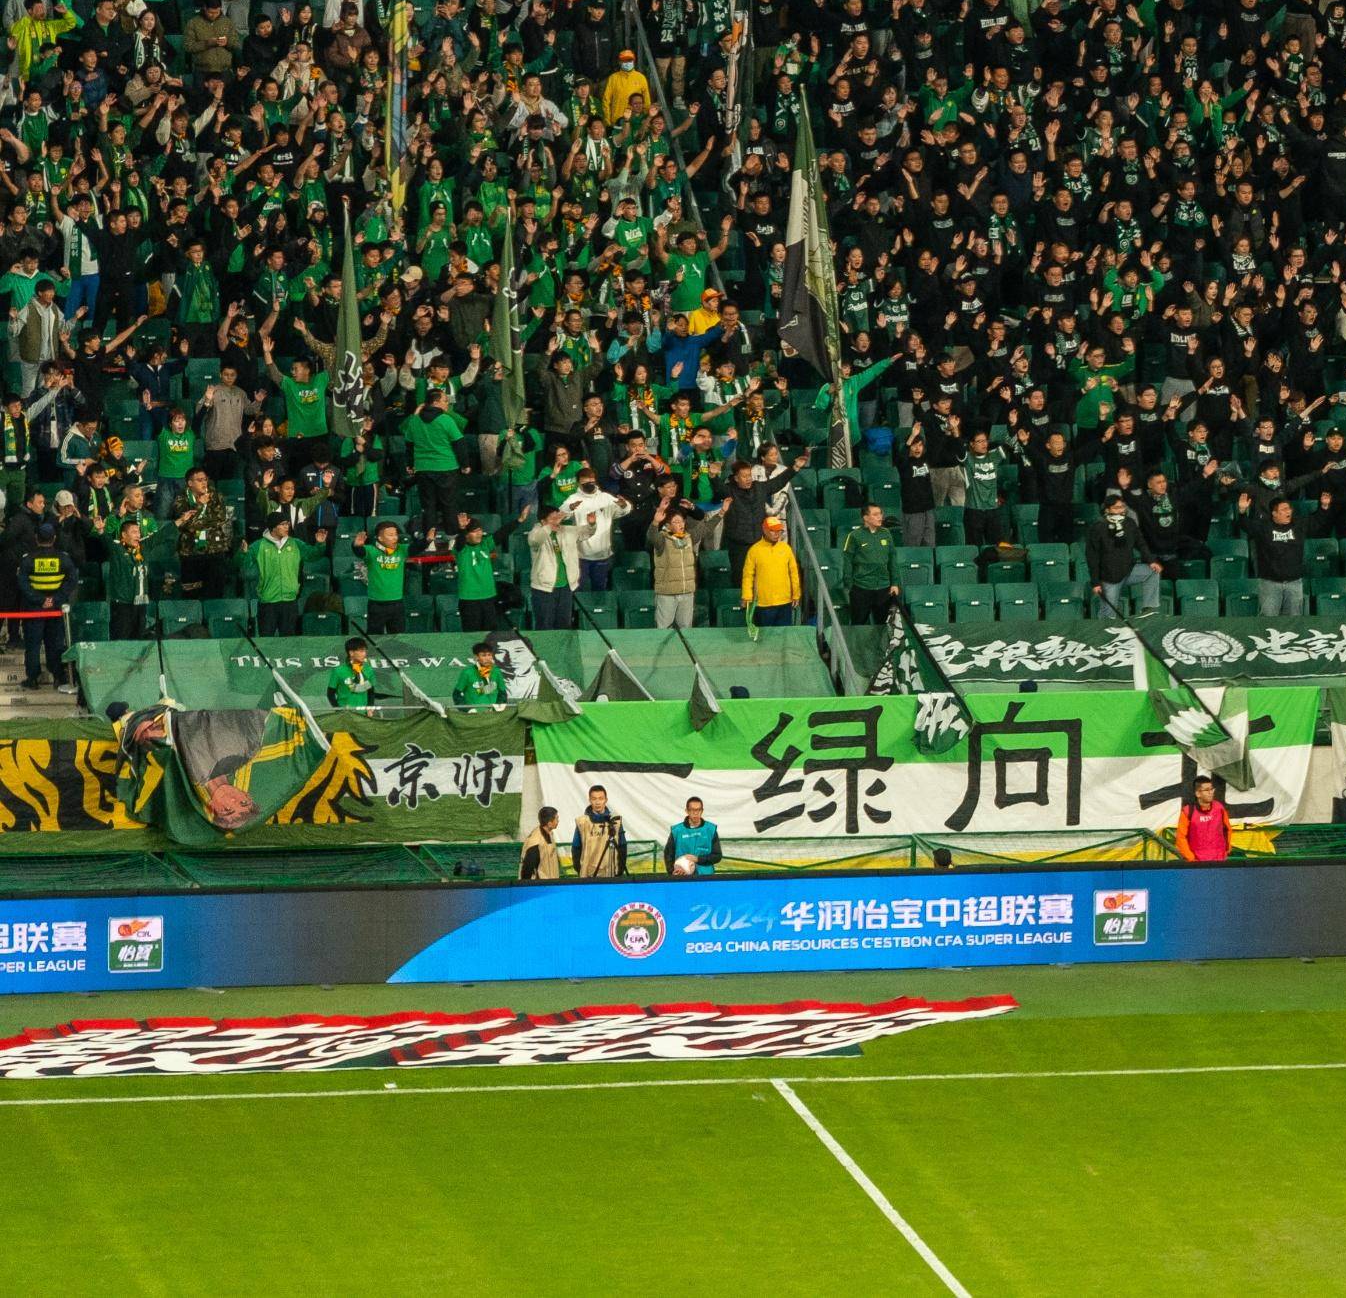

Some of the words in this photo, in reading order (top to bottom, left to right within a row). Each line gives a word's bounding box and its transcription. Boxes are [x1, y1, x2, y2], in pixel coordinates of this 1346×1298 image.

[310, 654, 340, 668] IS
[686, 941, 723, 954] 2024
[726, 940, 770, 953] CHINA
[773, 937, 859, 952] RESOURCES
[862, 936, 932, 950] C'ESTBON
[934, 934, 962, 947] CFA
[966, 933, 1013, 946] SUPER
[1016, 931, 1073, 945] LEAGUE
[29, 959, 87, 973] LEAGUE
